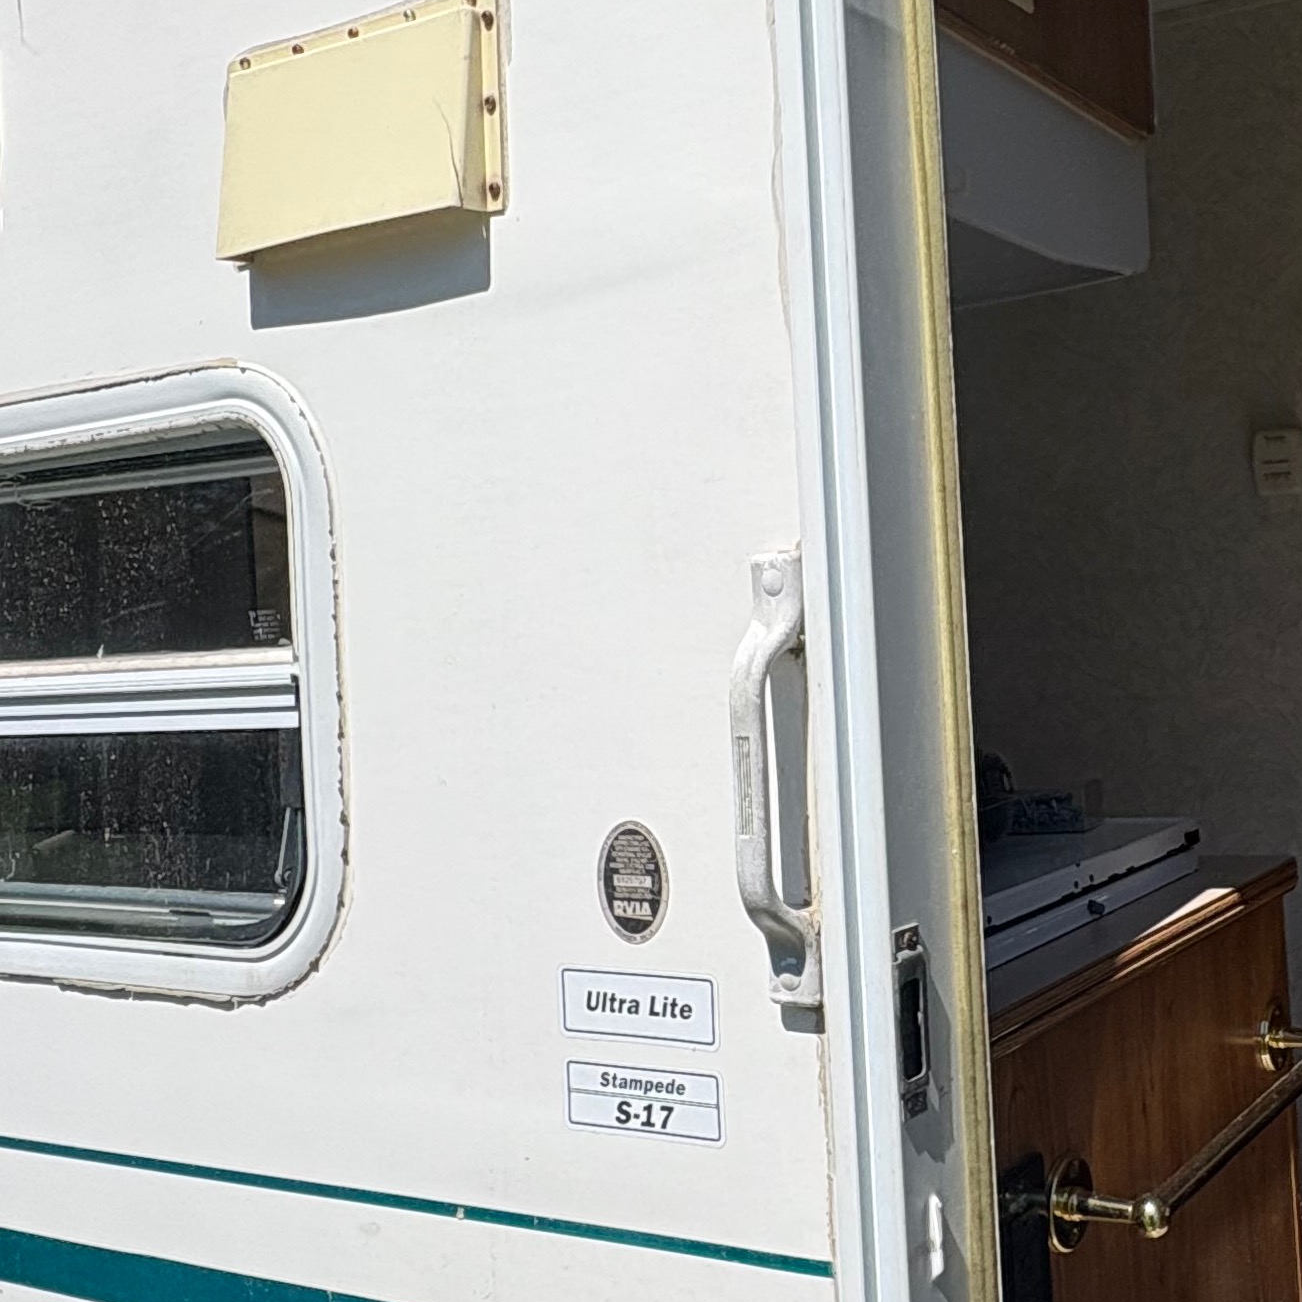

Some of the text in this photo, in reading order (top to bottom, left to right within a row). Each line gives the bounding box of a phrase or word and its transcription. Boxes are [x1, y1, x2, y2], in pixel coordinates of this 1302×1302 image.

[586, 990, 693, 1020] Ultra Lite
[600, 1071, 686, 1096] Stampede
[615, 1100, 674, 1130] S-17
